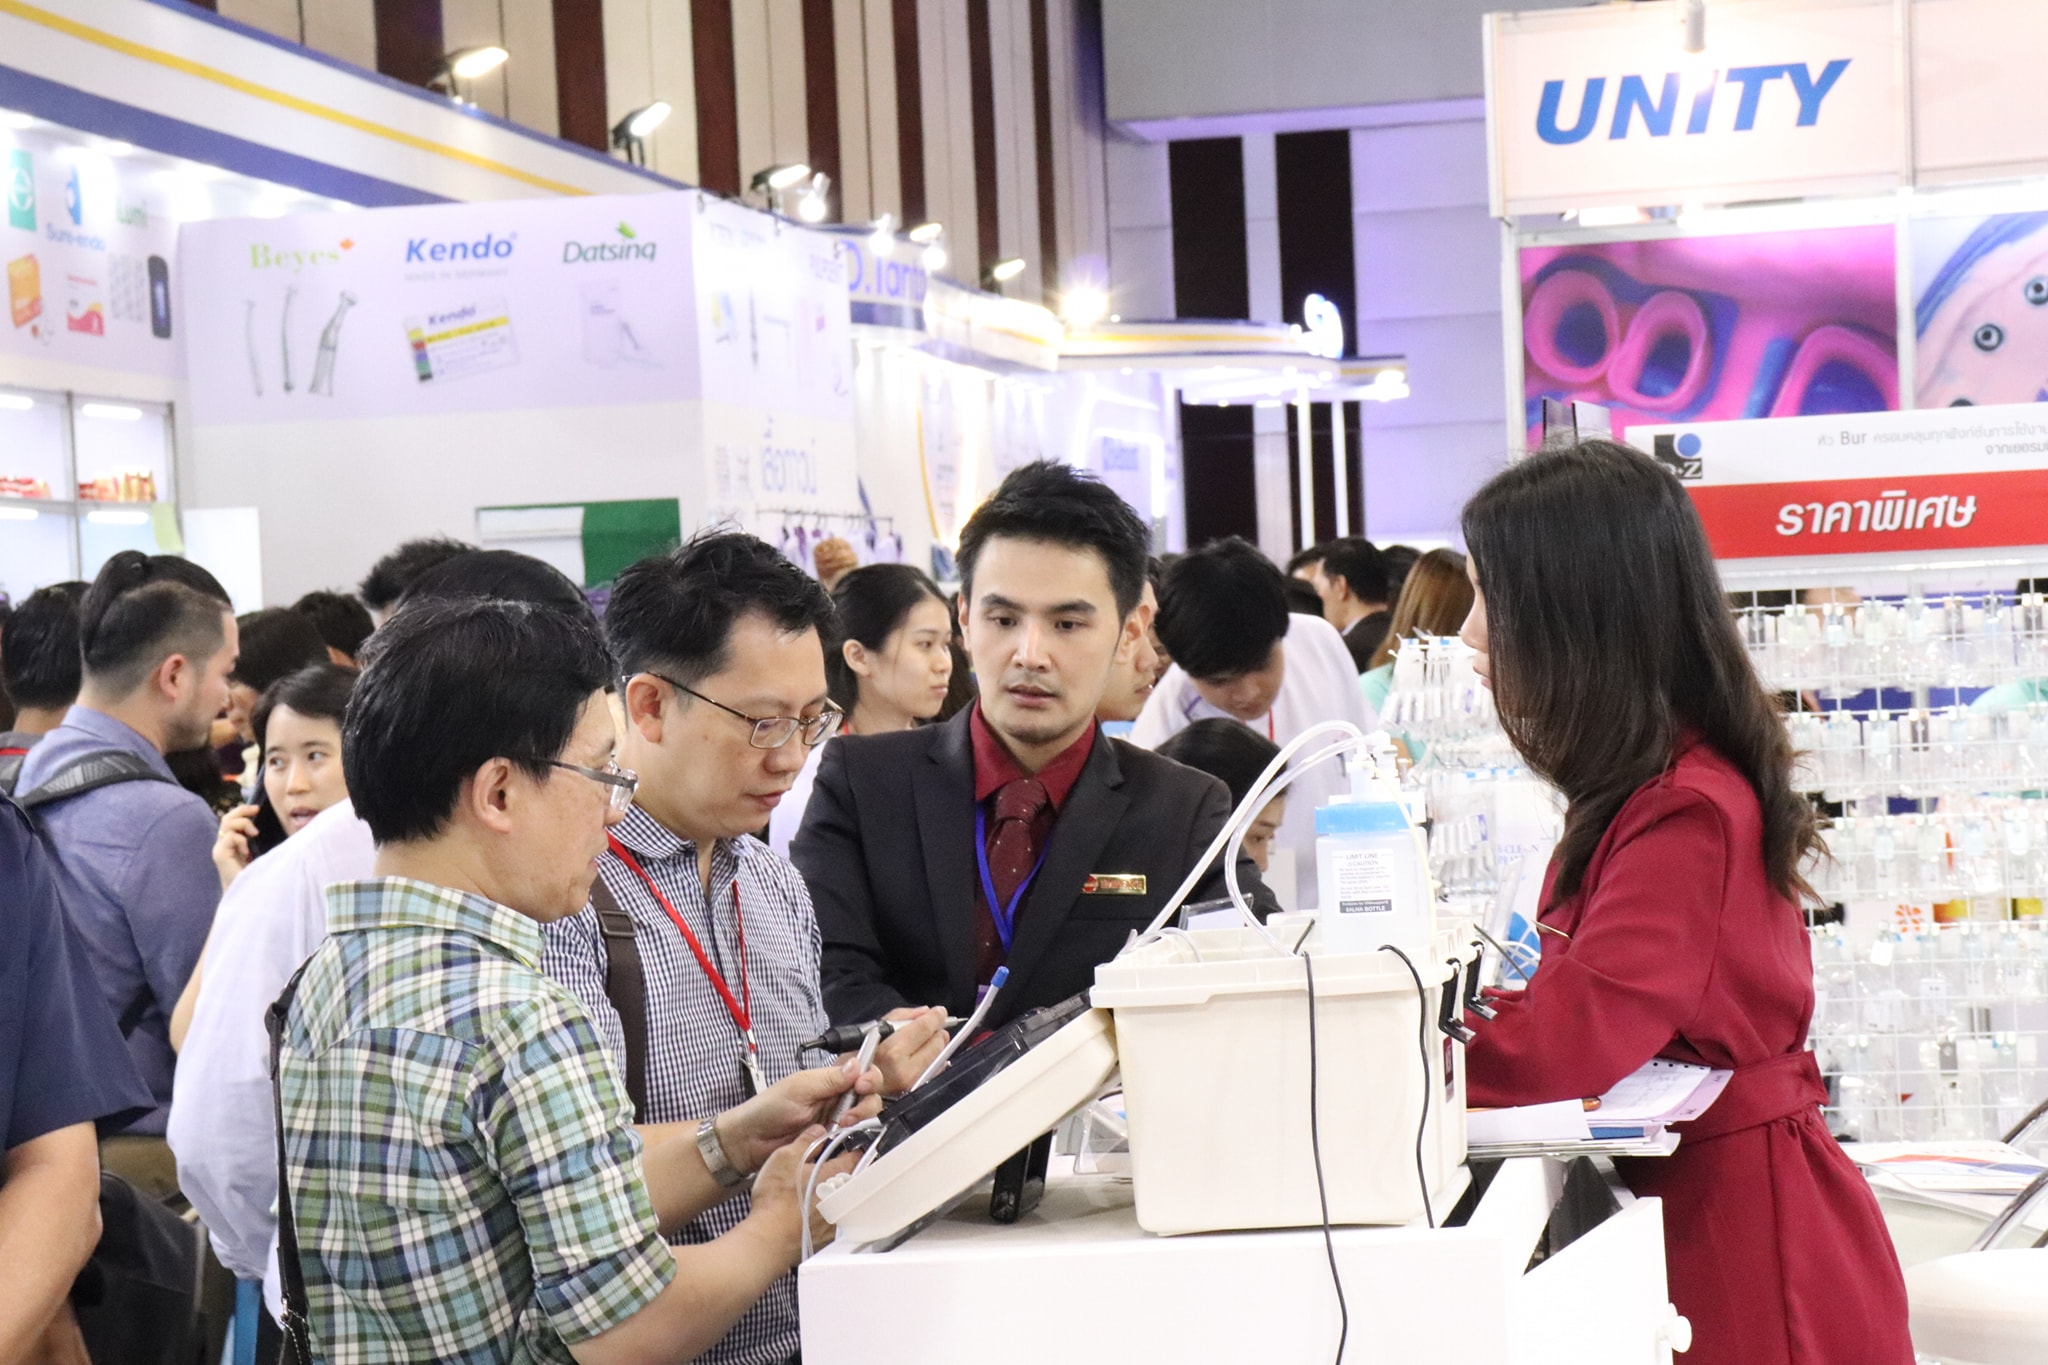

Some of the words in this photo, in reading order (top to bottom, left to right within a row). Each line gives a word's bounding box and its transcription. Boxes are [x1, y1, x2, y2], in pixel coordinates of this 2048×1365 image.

[1535, 58, 1853, 146] UNITY
[249, 244, 340, 275] Beyes
[405, 233, 514, 263] Kendo
[428, 305, 477, 325] Kendo
[1840, 431, 1868, 446] Bur
[1775, 490, 1977, 536] ราคาพิเศษ
